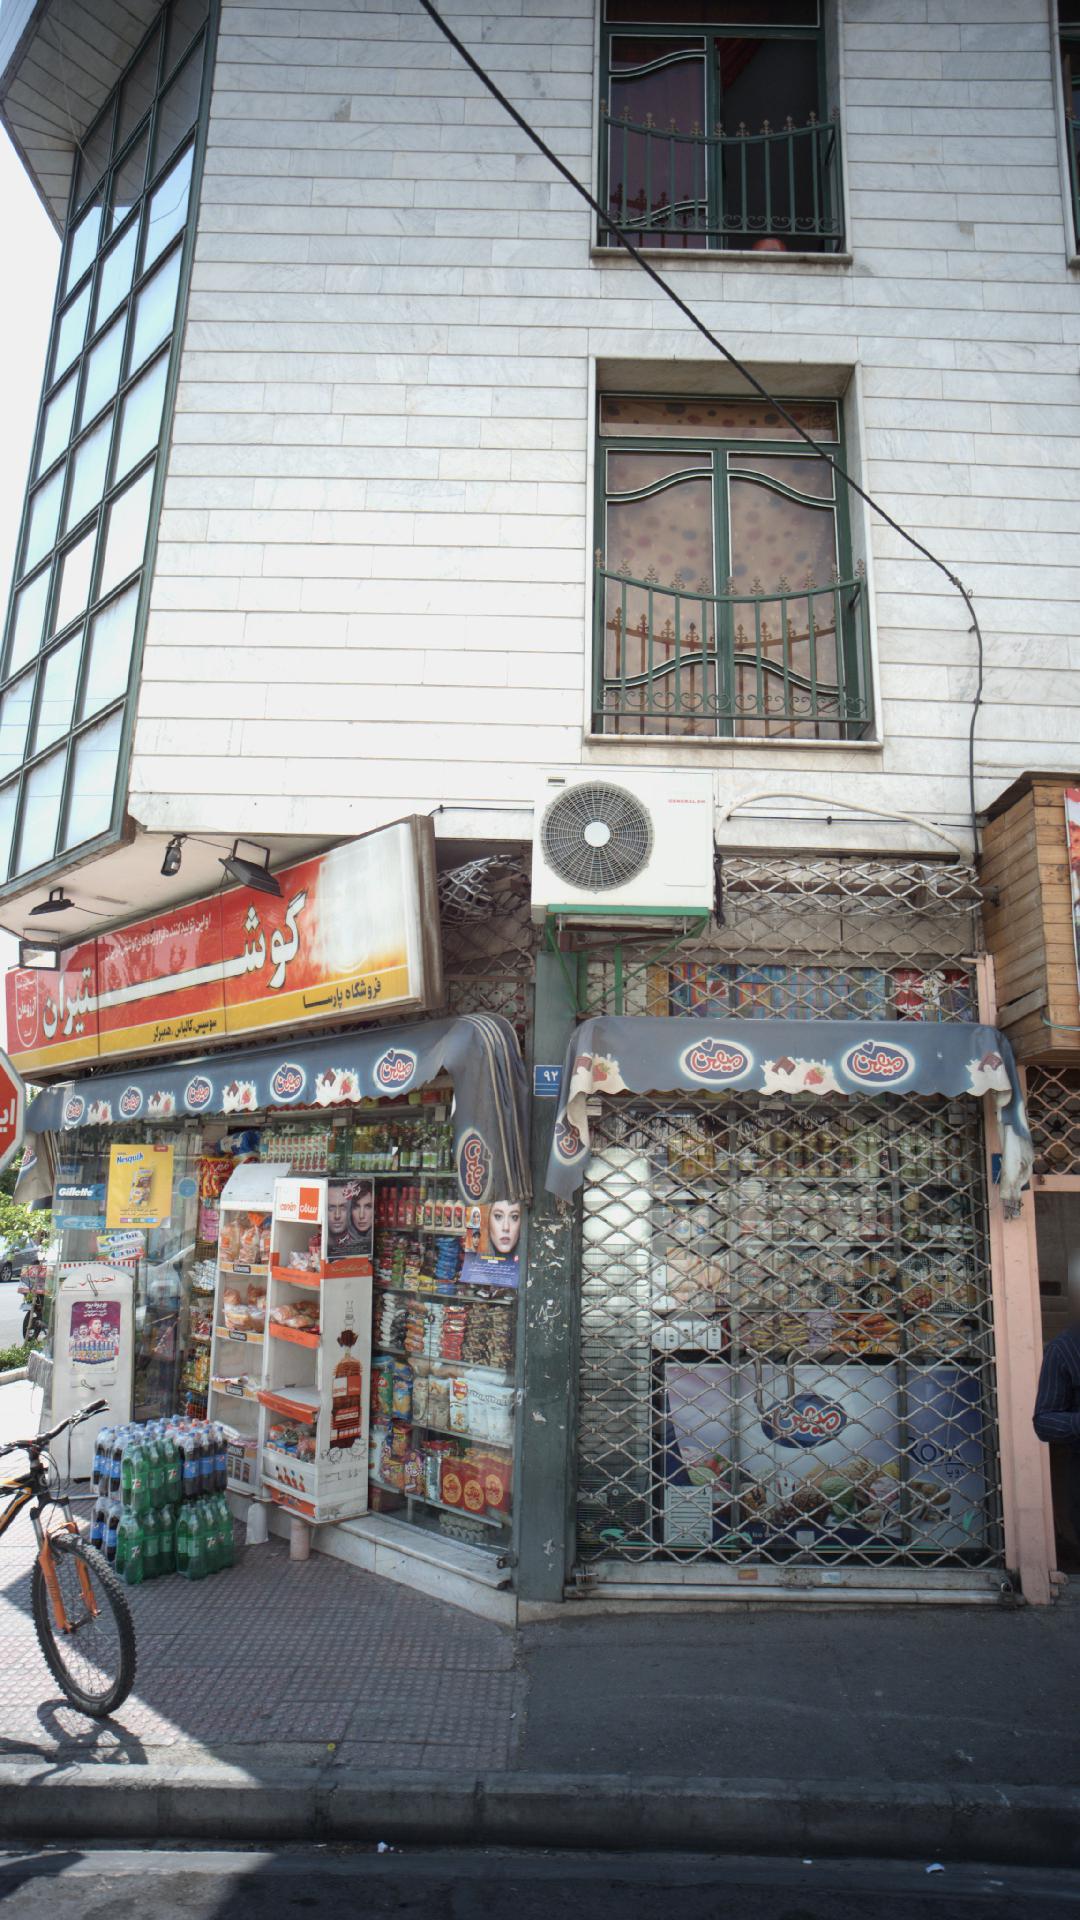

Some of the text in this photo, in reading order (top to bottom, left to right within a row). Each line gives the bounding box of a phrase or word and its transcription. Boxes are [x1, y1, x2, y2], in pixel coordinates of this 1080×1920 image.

[196, 913, 212, 933] اولین
[43, 888, 308, 1039] گوشتیران
[302, 977, 382, 1009] فروشگاه پارسا
[380, 1058, 414, 1083] میهن
[691, 1050, 743, 1073] میهن
[853, 1053, 906, 1075] میهن
[275, 1072, 302, 1095] میهن
[543, 1070, 559, 1082] ۹۲
[187, 1085, 210, 1104] میهن
[116, 1152, 145, 1165] Nesquik
[464, 1138, 485, 1197] میهن
[58, 1186, 94, 1197] Gillette
